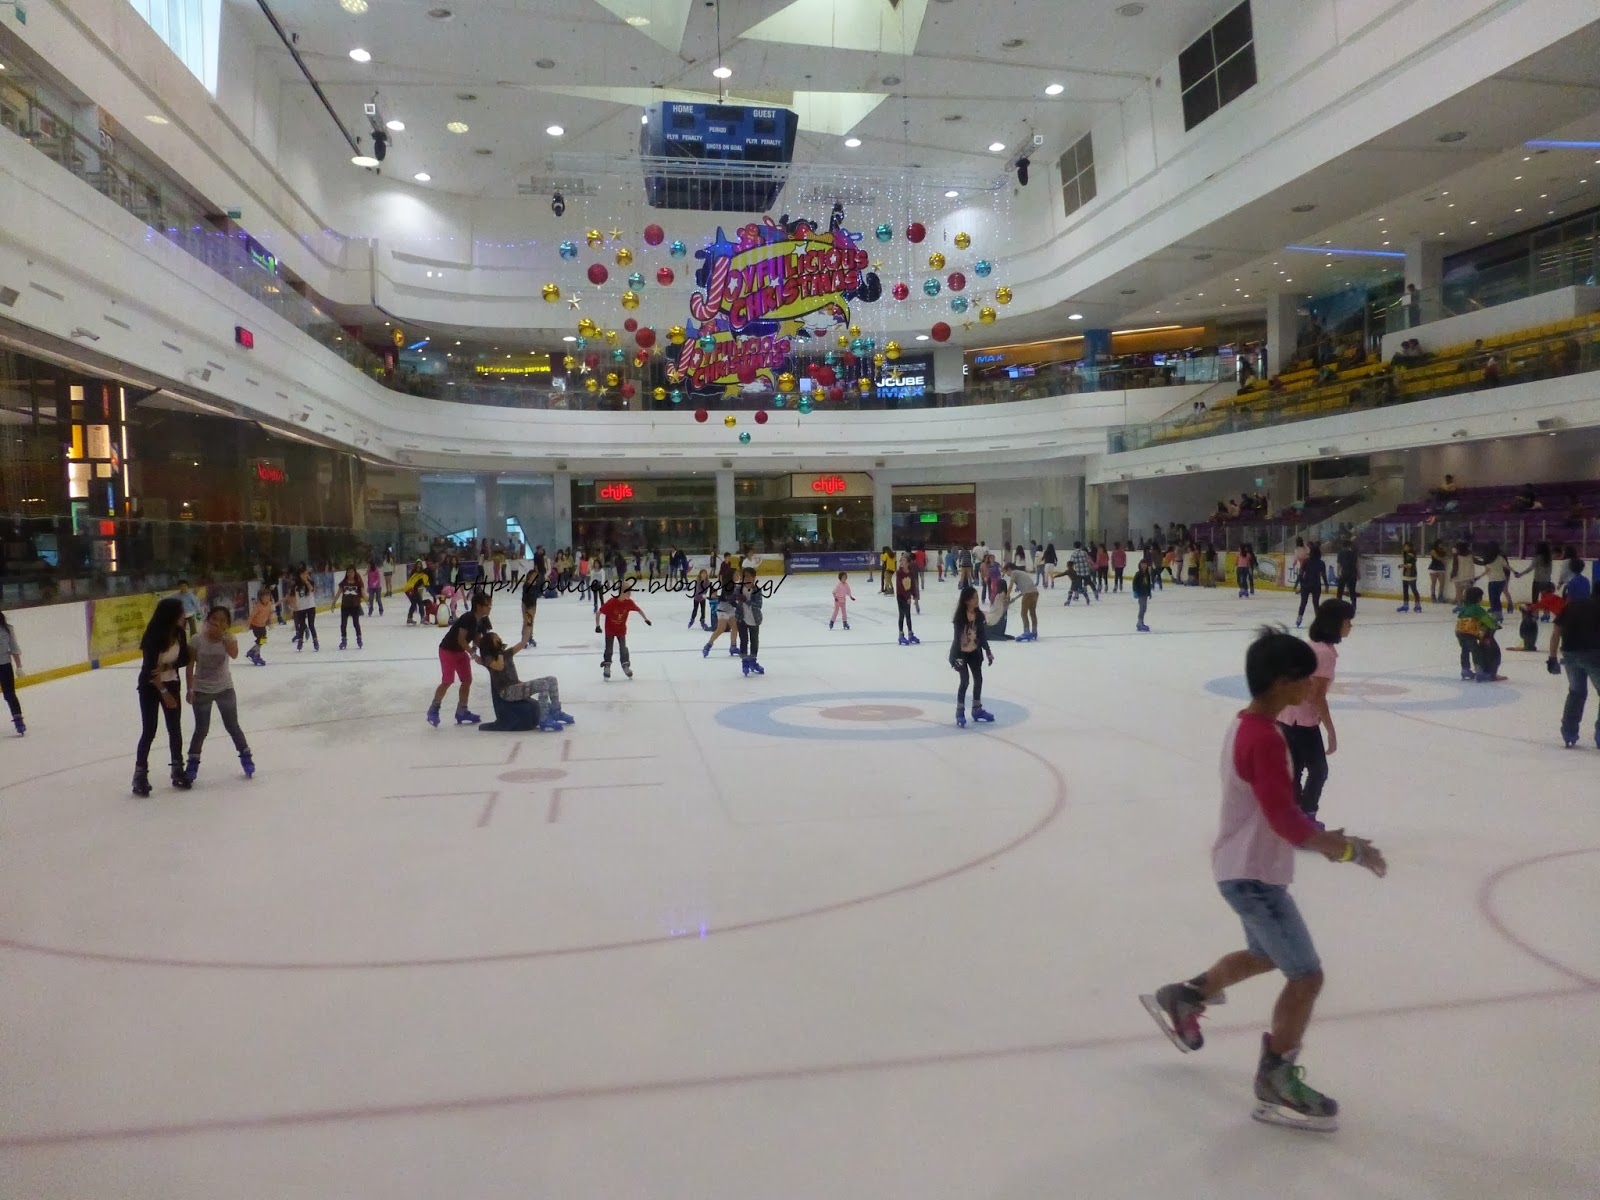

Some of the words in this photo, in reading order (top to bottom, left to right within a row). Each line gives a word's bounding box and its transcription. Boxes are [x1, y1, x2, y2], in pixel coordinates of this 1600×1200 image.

[672, 105, 694, 114] HOME
[753, 109, 776, 119] GUEST
[761, 138, 782, 146] PENALTY
[731, 269, 860, 329] CHRISTMAS
[974, 354, 1004, 364] IMAX
[876, 376, 925, 387] JCUBE
[876, 386, 925, 398] IMAX
